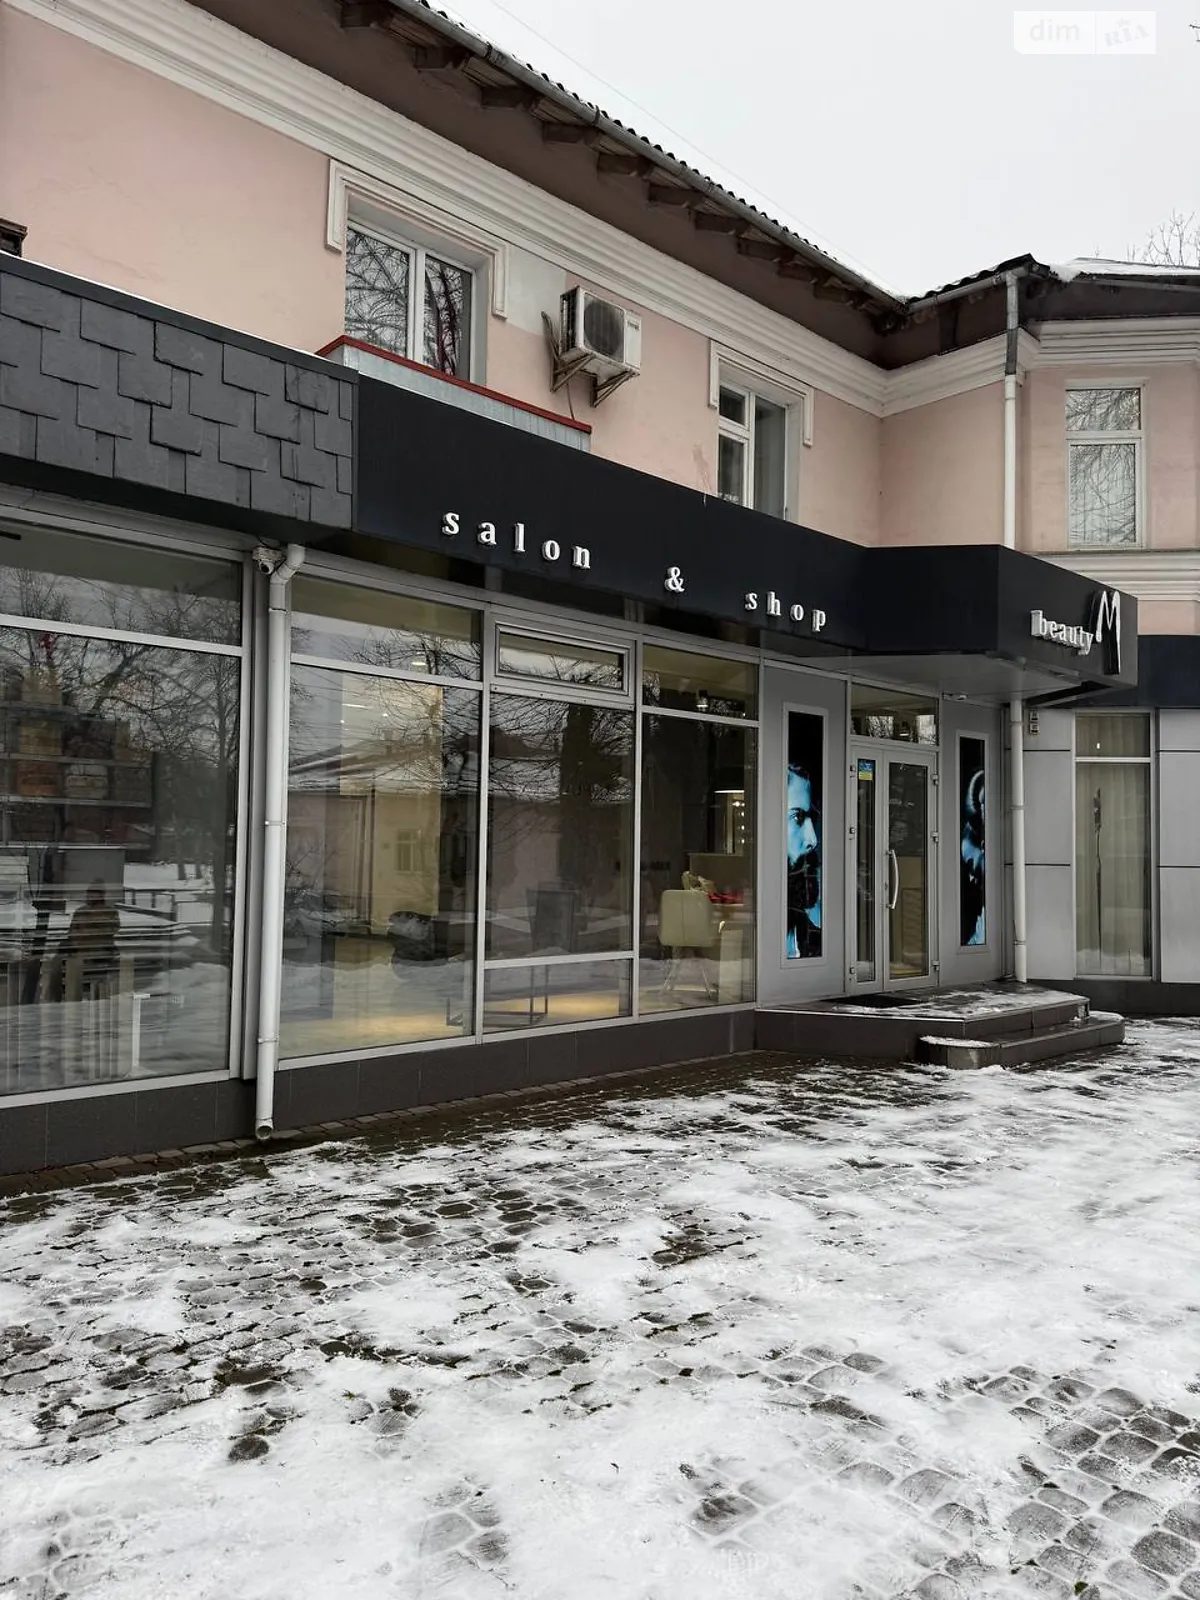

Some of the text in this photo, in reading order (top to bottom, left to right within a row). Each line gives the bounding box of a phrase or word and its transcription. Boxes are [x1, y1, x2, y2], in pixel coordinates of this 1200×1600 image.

[442, 512, 827, 632] salon & shop
[1030, 609, 1094, 656] beauty
